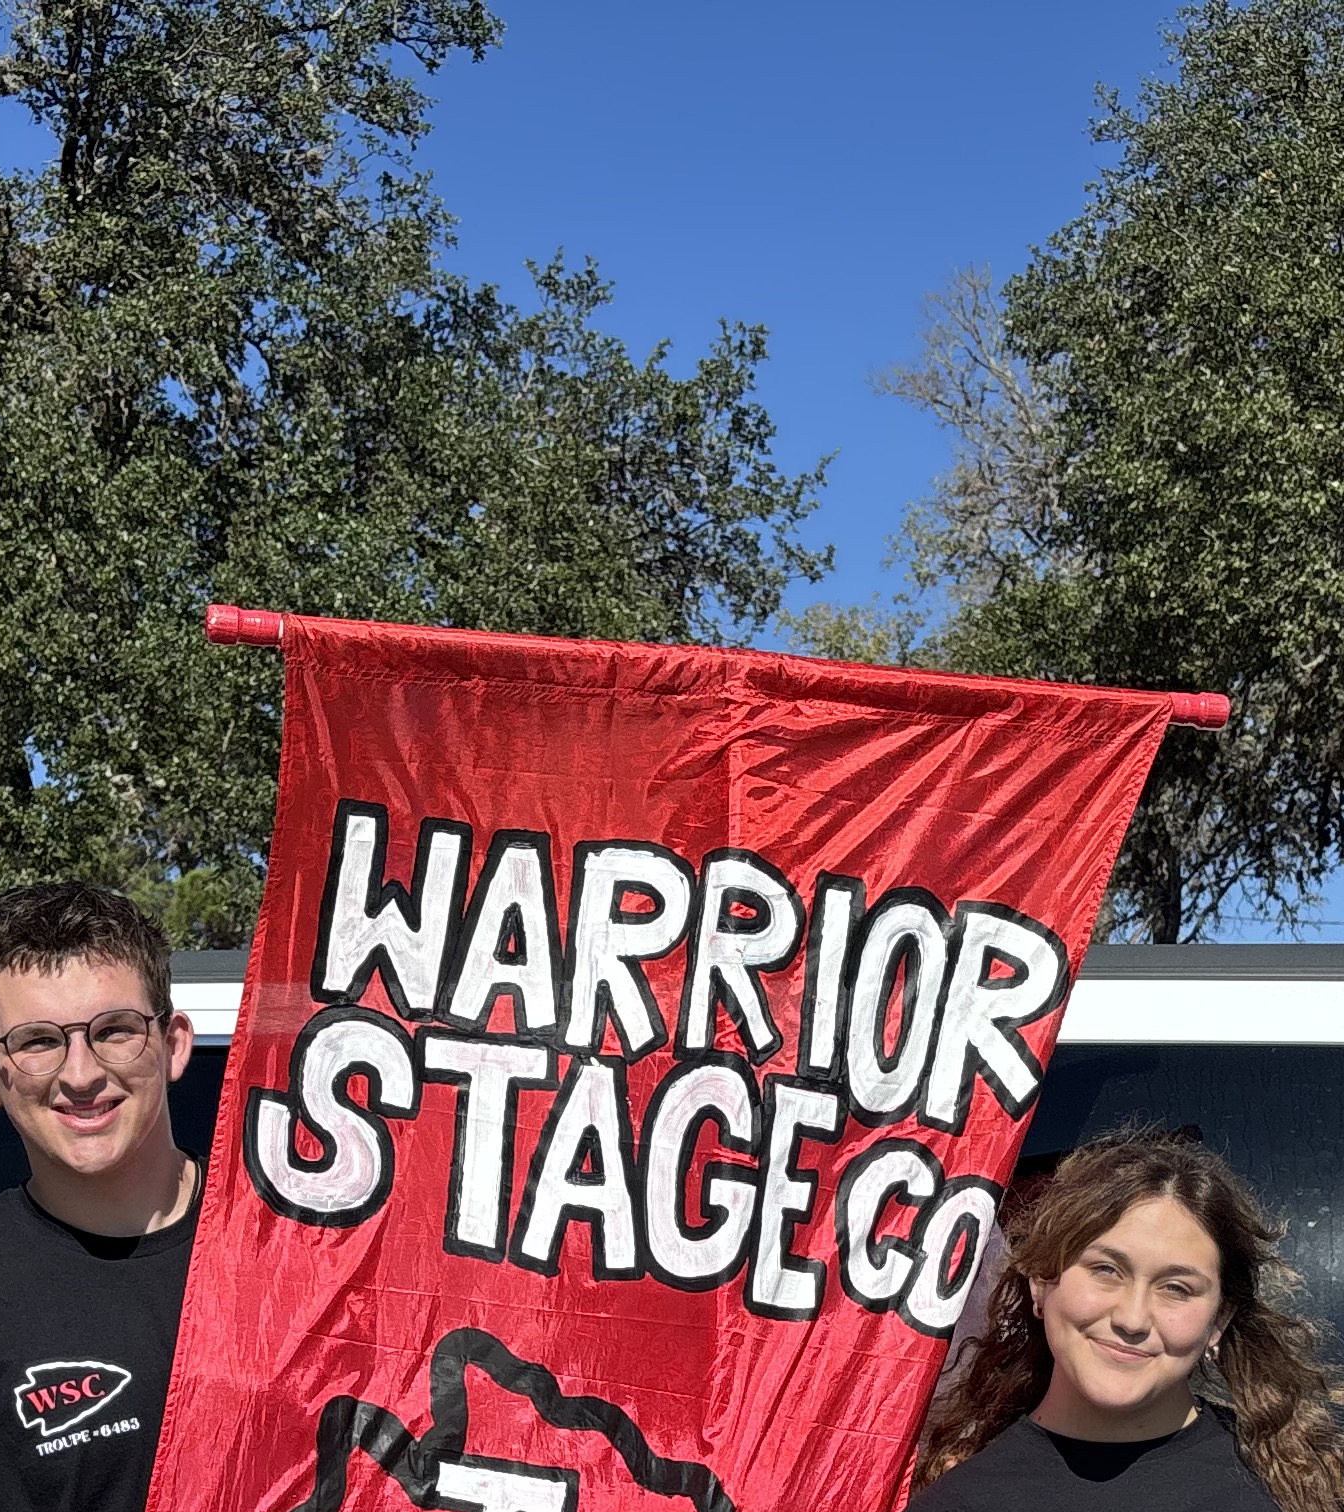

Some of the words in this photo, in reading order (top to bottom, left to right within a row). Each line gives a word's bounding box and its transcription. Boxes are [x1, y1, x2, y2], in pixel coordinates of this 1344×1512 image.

[311, 799, 1069, 1134] WARRIOR
[245, 1006, 850, 1320] STAGE
[835, 1137, 1007, 1338] CO
[26, 1373, 106, 1414] WSC
[36, 1430, 91, 1456] TROUPE
